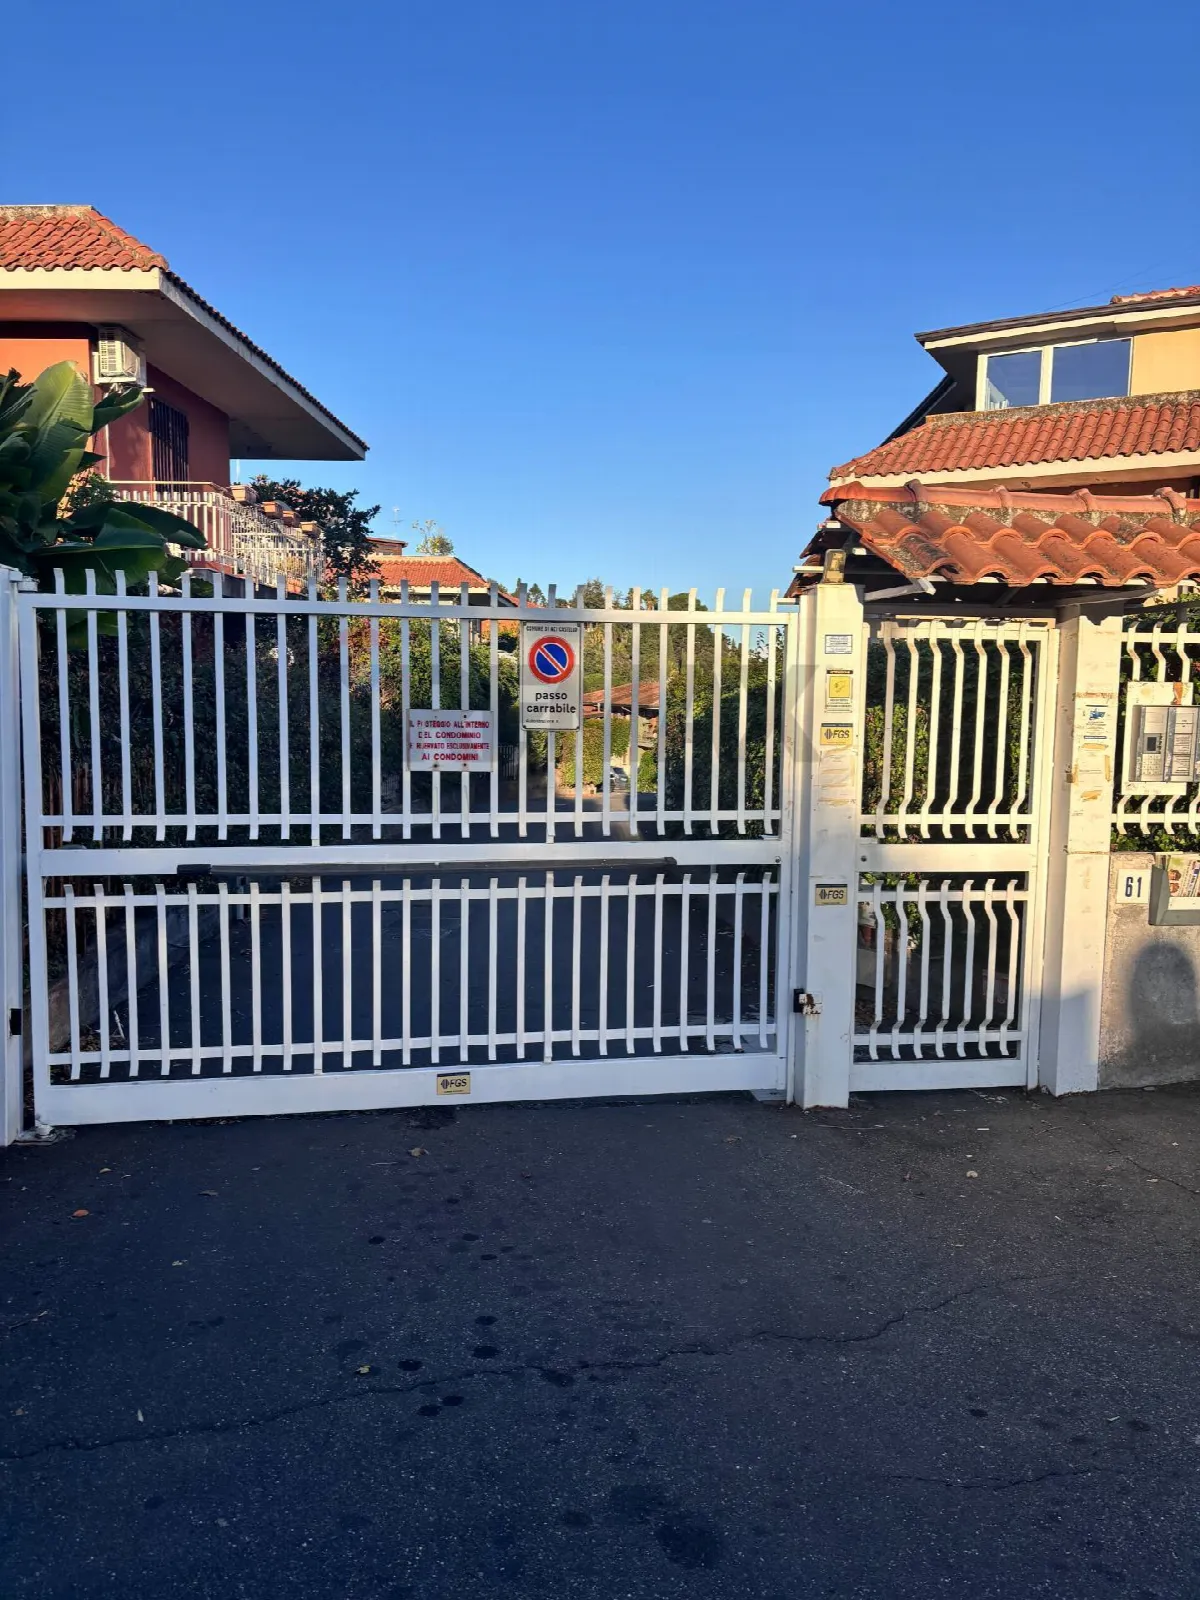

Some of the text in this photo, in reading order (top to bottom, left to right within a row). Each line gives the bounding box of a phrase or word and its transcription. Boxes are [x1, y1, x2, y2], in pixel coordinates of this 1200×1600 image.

[535, 692, 568, 702] passo
[526, 703, 577, 714] carrabile
[435, 731, 481, 739] CONDOMINIO
[833, 730, 850, 739] FGS
[421, 753, 479, 761] AI CONDOMINI
[1125, 876, 1143, 898] 61
[827, 890, 844, 899] FGS
[450, 1078, 467, 1087] FGS
